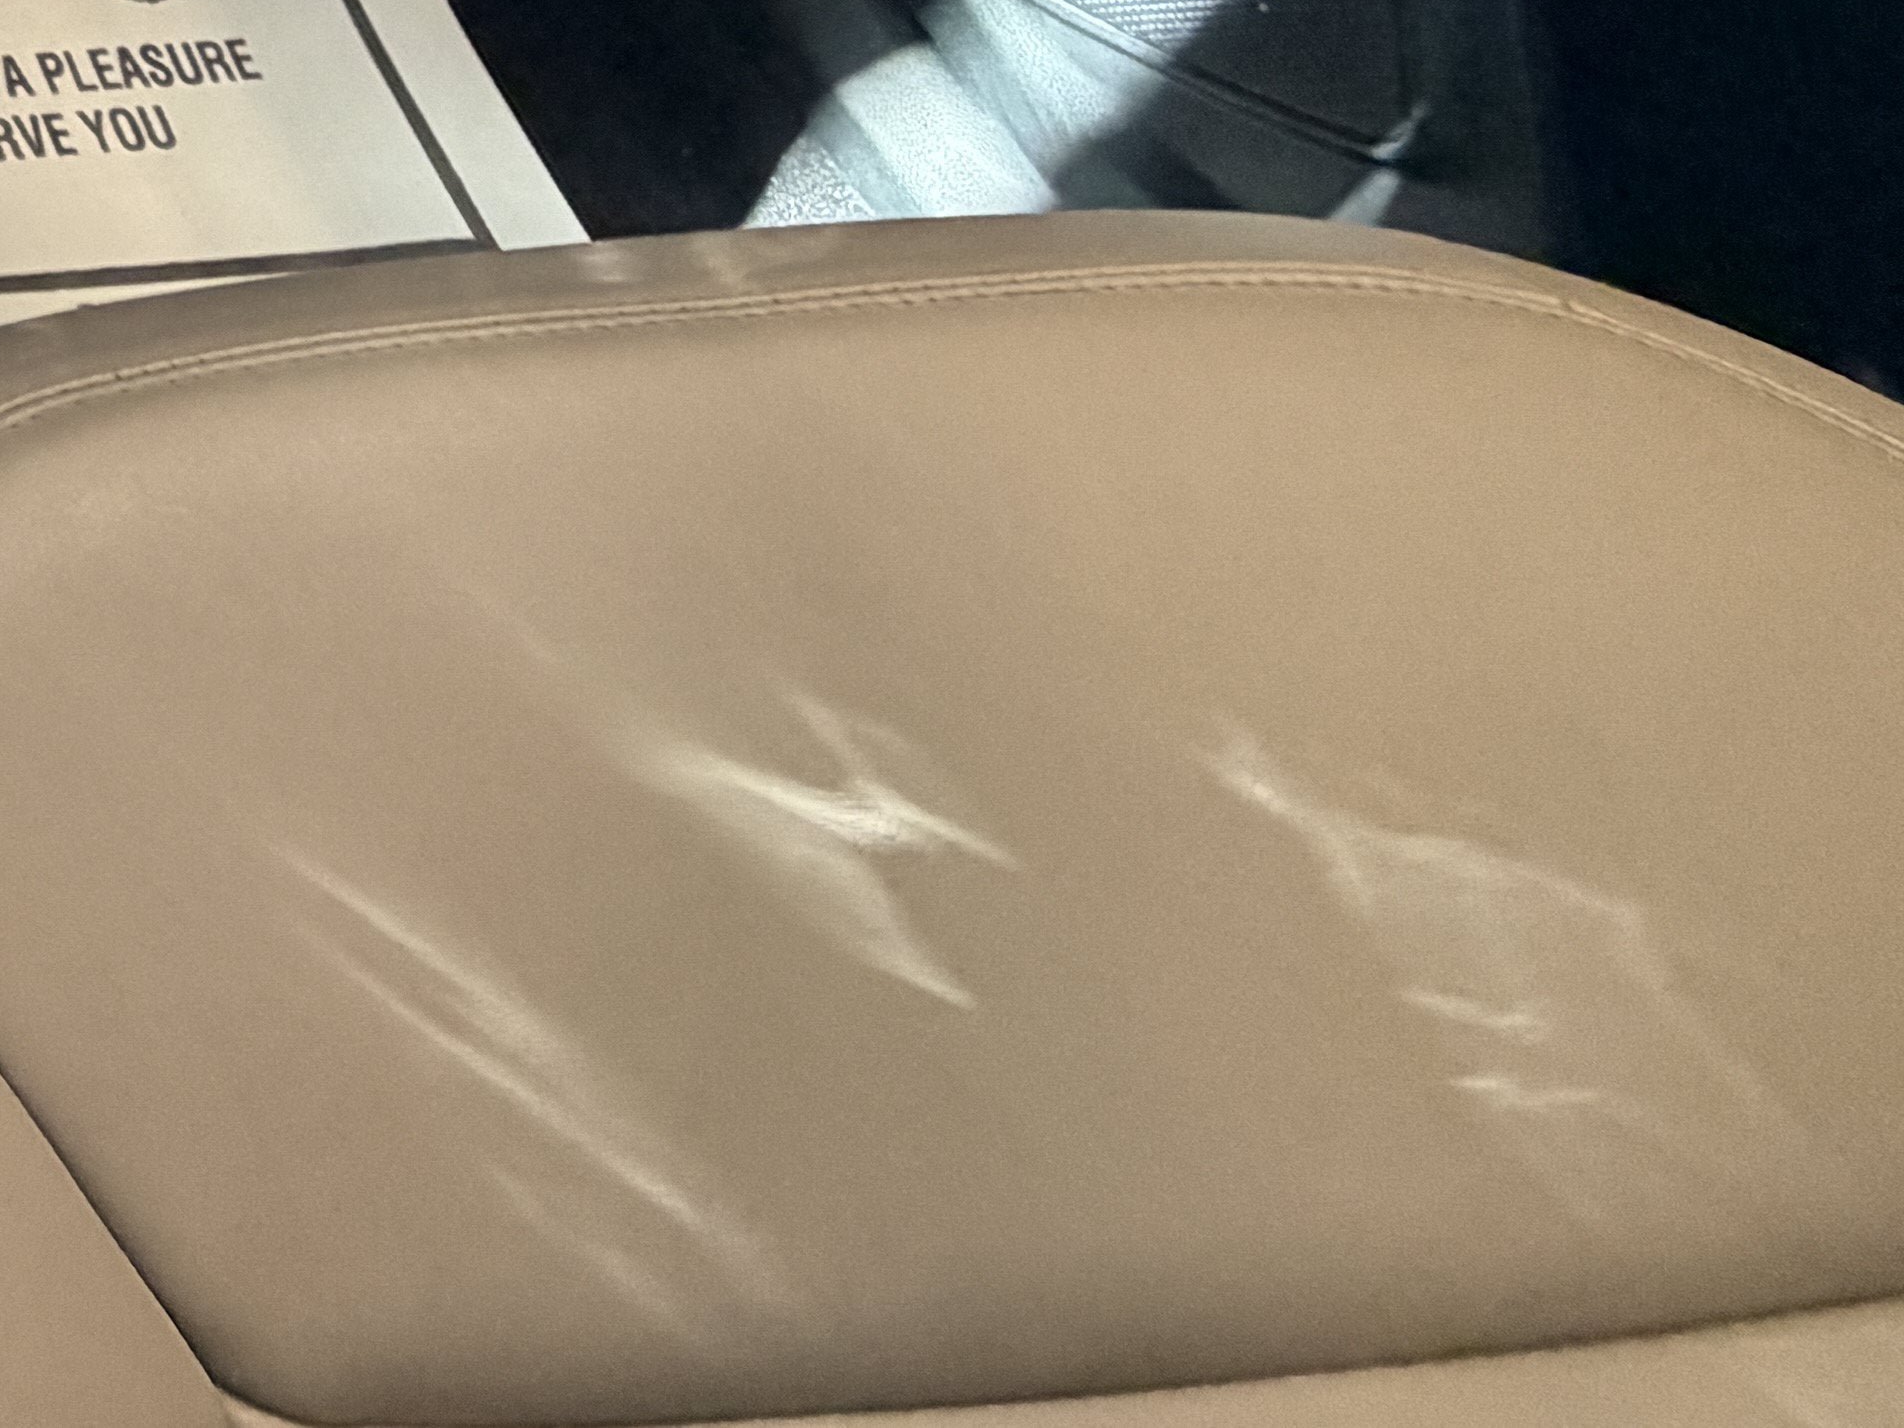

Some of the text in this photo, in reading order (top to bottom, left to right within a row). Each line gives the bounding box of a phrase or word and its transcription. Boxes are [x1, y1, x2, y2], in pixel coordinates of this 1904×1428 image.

[0, 53, 37, 99] A
[37, 37, 263, 98] PLEASURE
[76, 103, 178, 153] YOU
